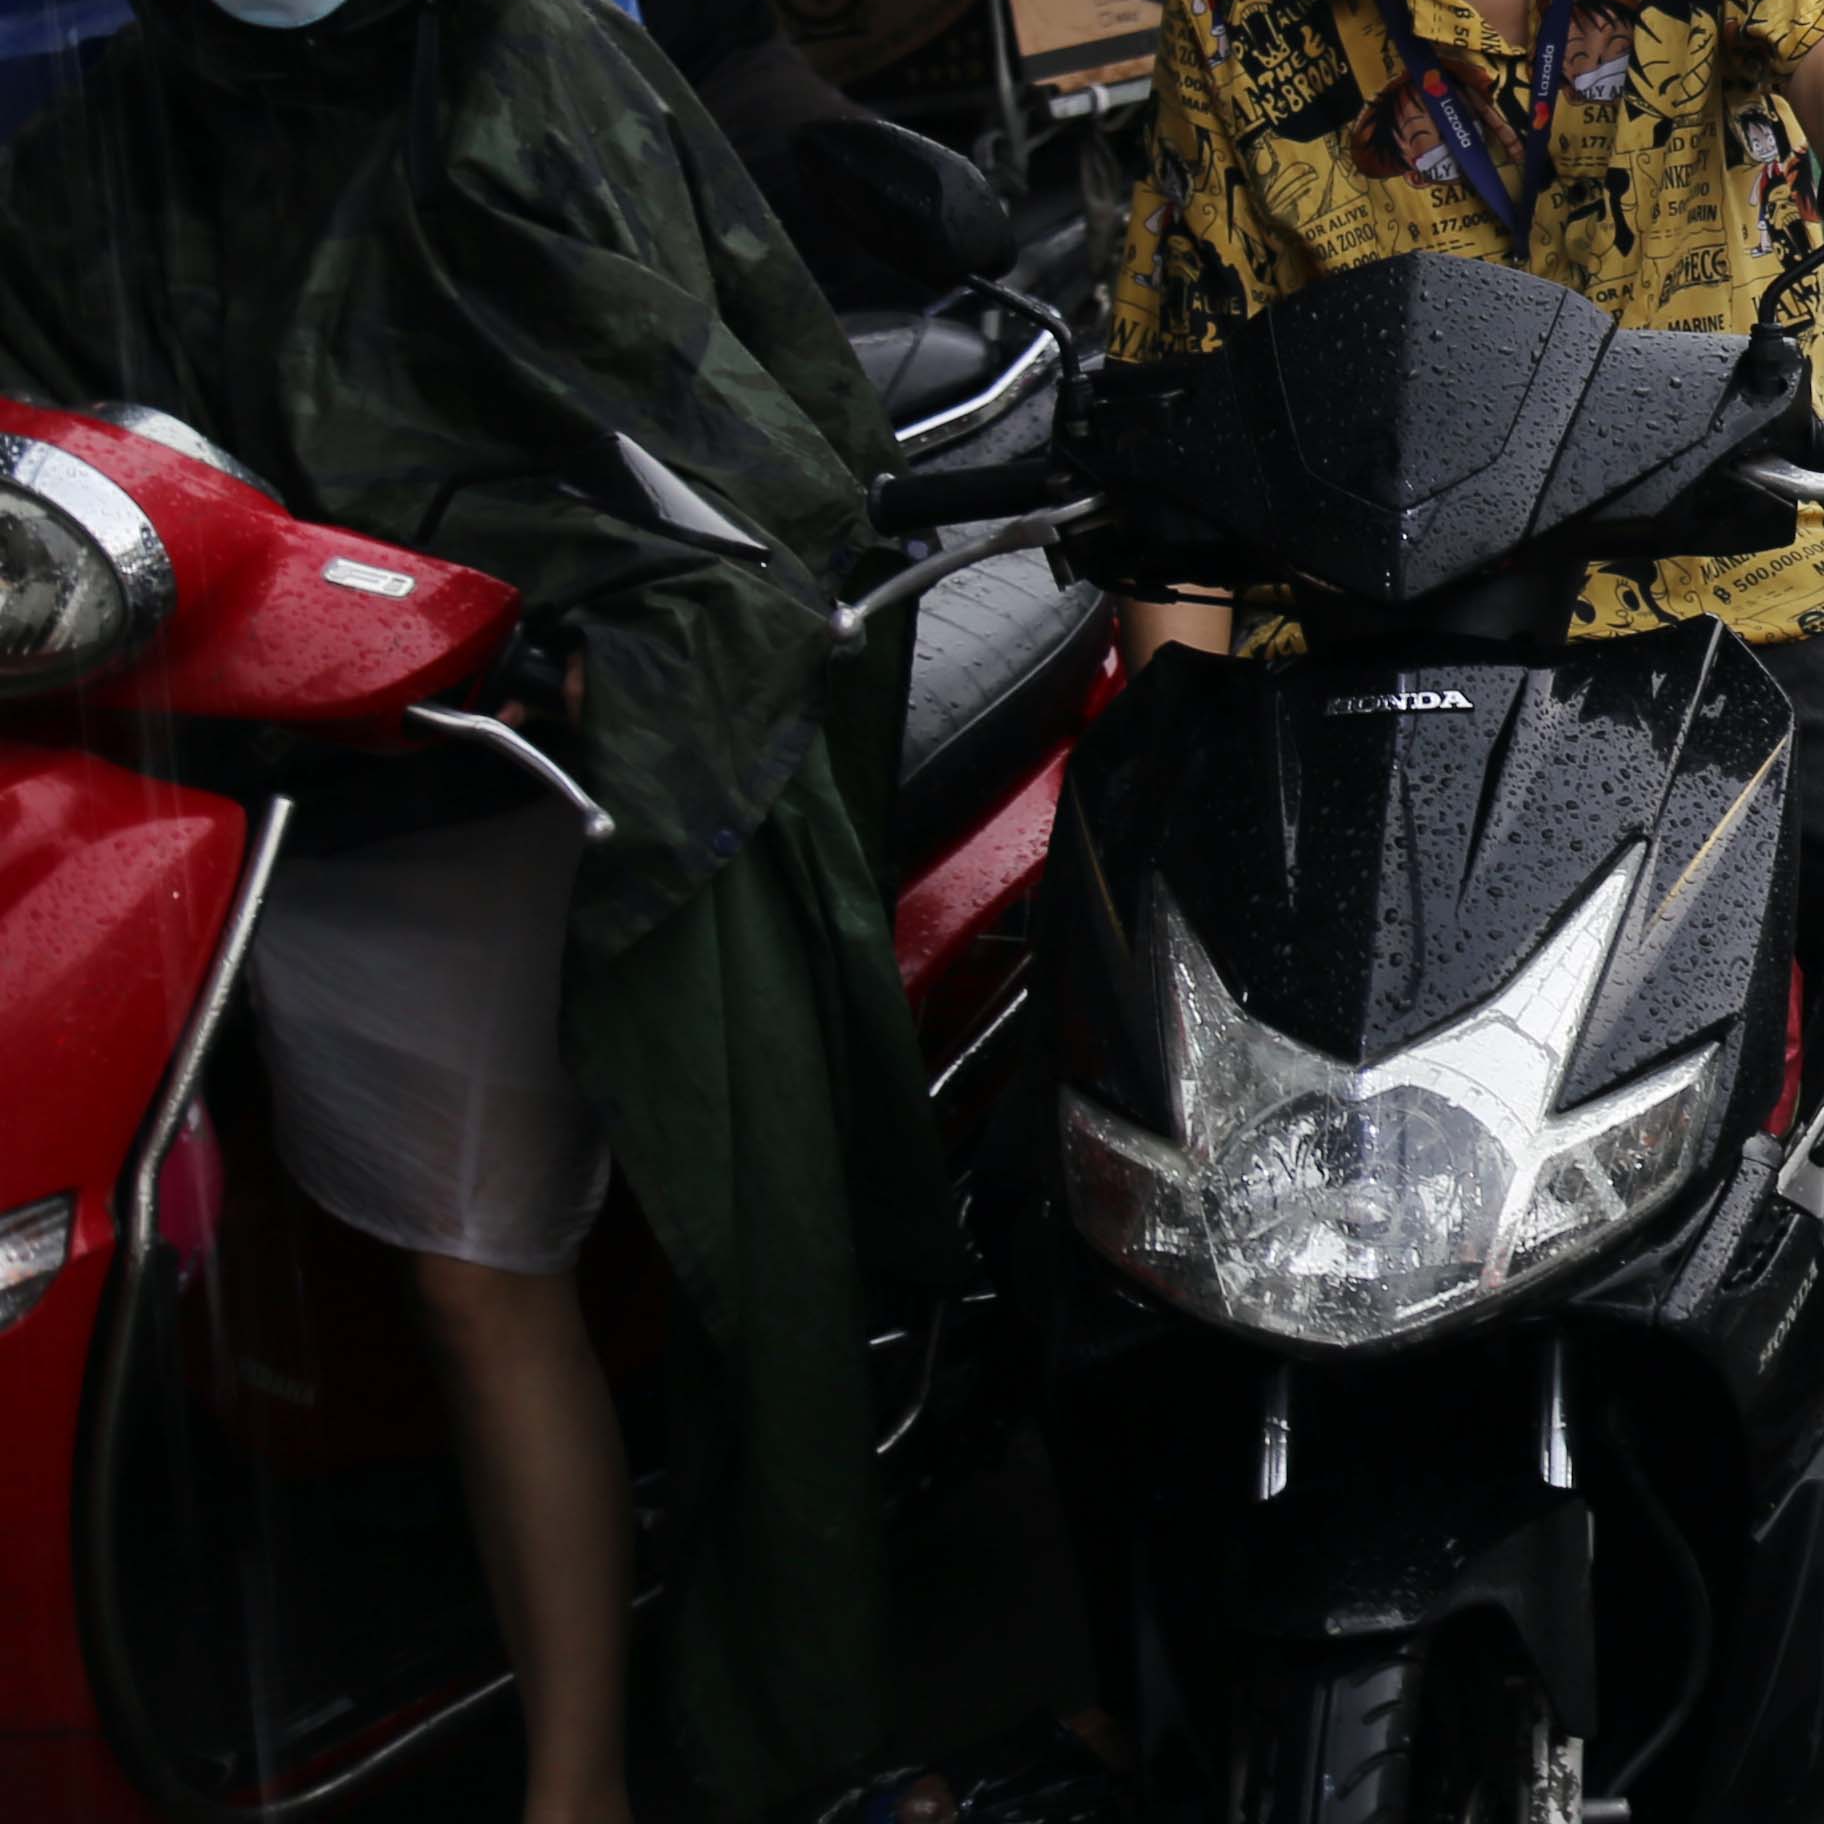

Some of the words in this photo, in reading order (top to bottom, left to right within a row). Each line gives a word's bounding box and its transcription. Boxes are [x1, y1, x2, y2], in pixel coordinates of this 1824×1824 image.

[1538, 44, 1555, 97] Lazada
[1440, 97, 1472, 149] Lazada
[1305, 223, 1328, 241] OR
[1329, 204, 1369, 232] ALIVE
[1326, 689, 1474, 716] HONDA
